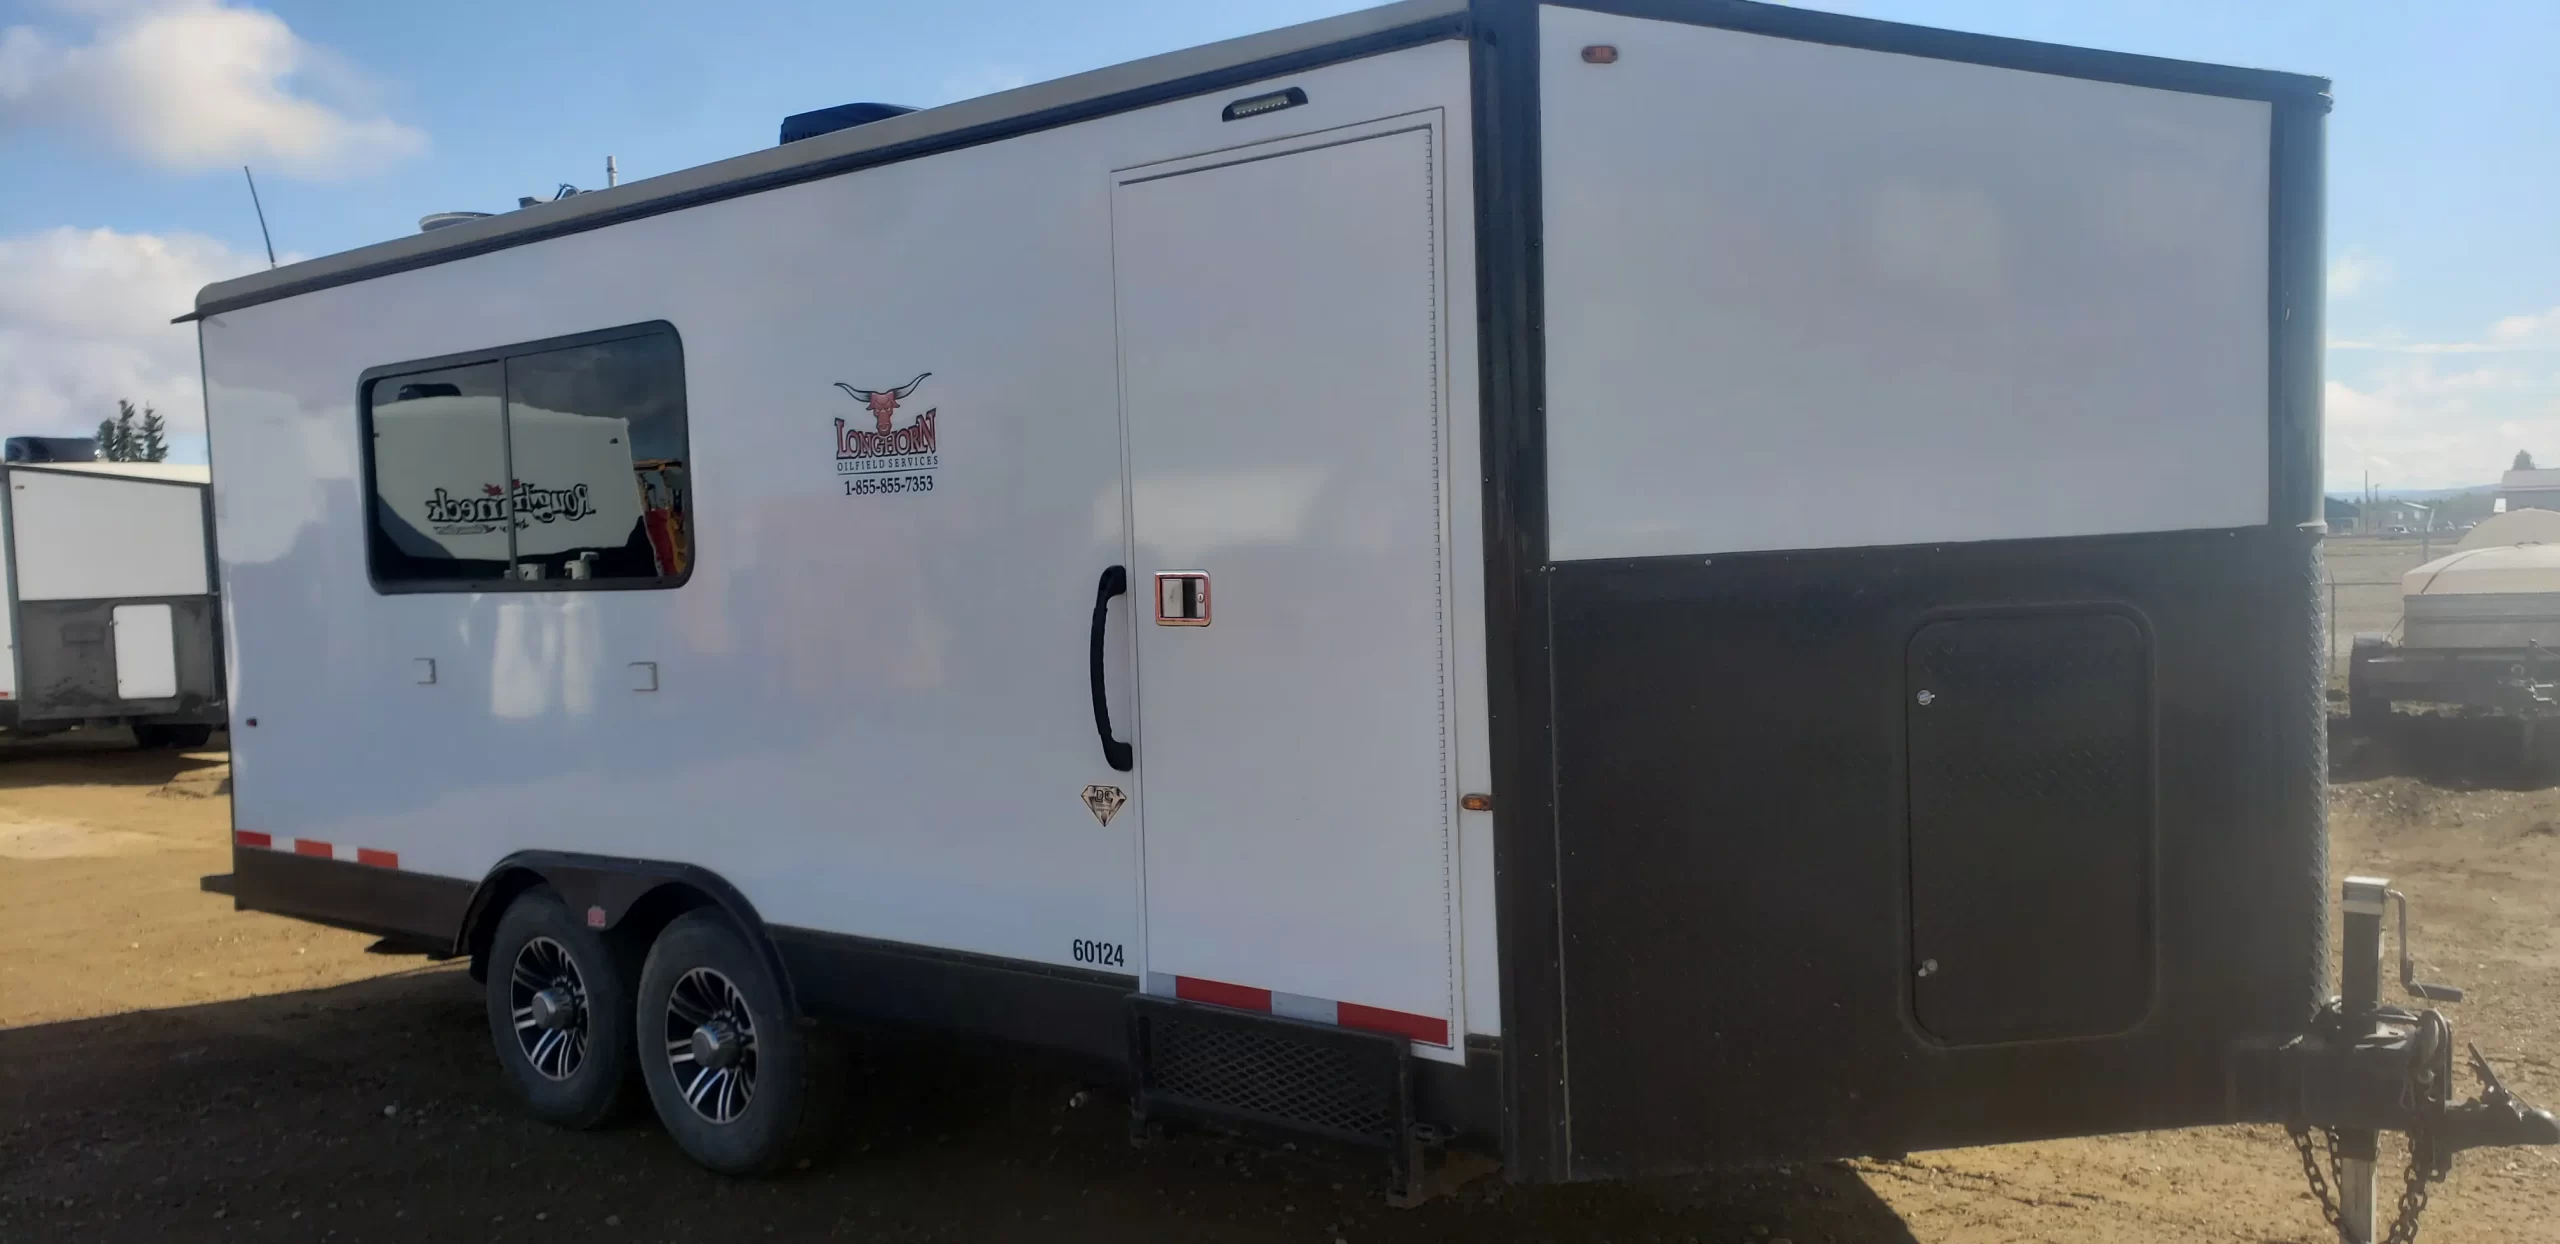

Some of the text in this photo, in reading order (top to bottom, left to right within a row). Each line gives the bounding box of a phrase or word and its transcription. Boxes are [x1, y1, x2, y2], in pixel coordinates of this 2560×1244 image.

[834, 407, 937, 460] LONGHORN
[837, 456, 938, 471] OILFIELD SERVICES
[844, 475, 934, 496] 1-855-855-7353
[1073, 938, 1125, 967] 60124
